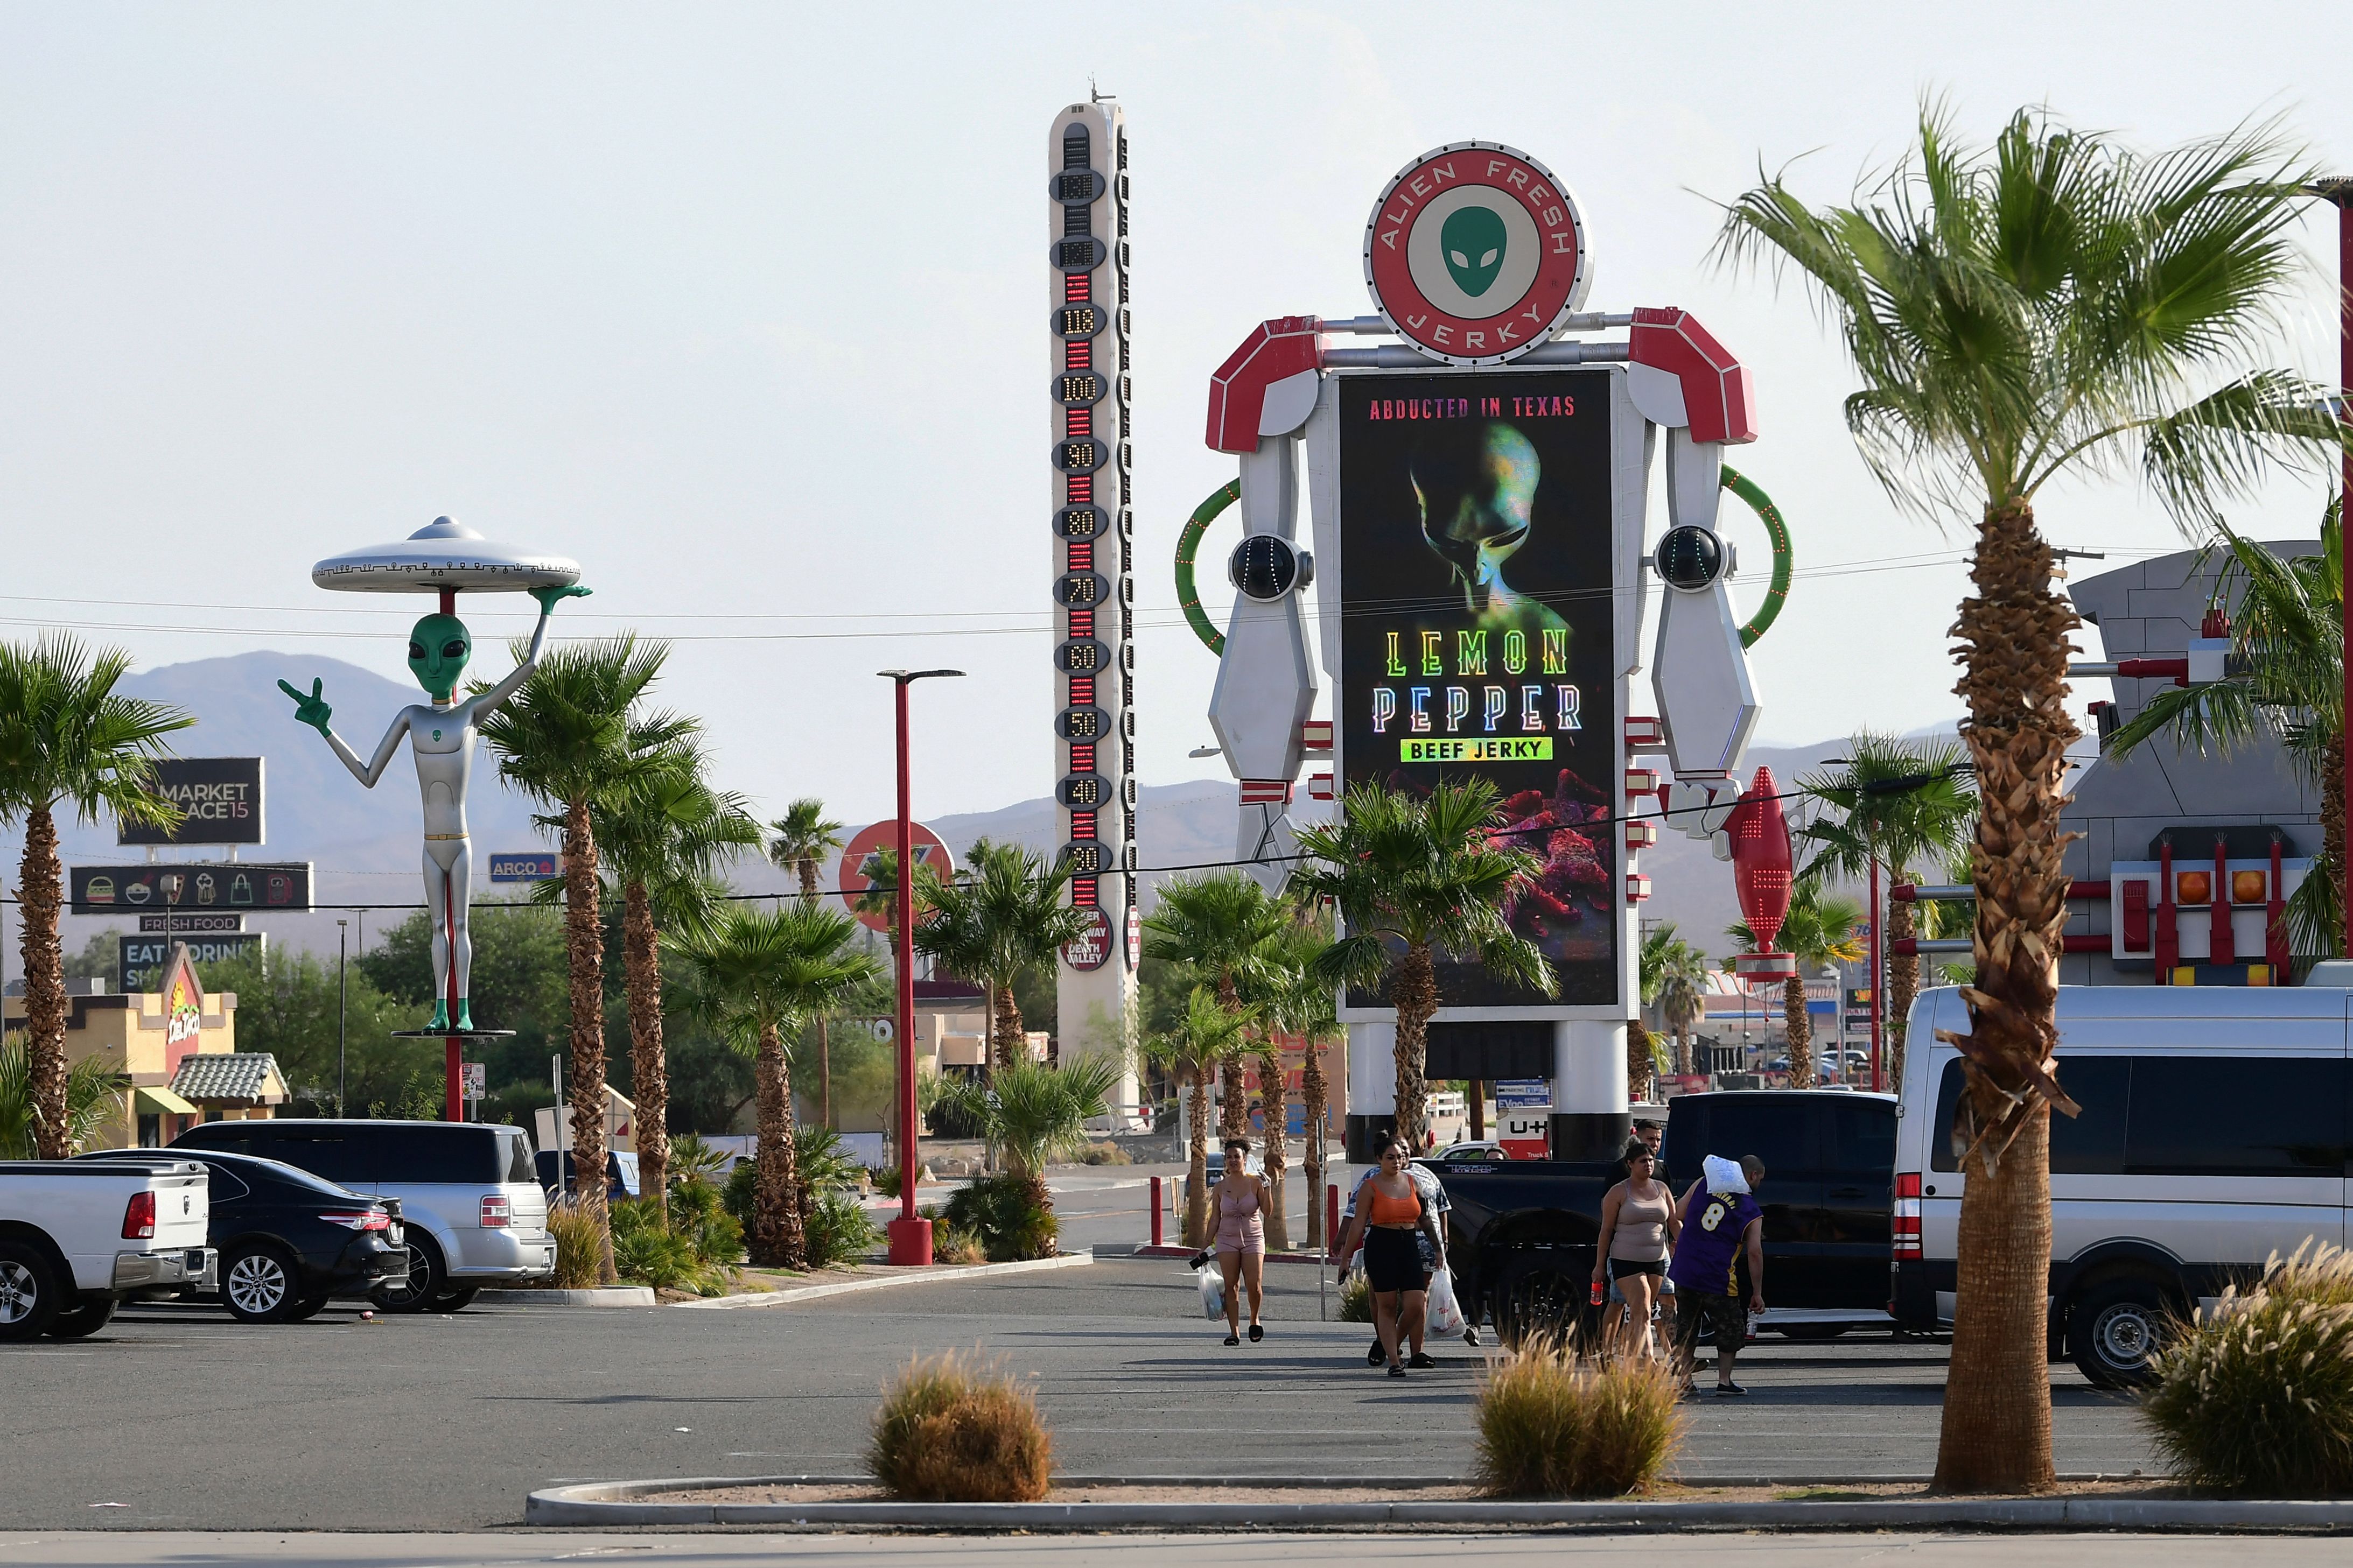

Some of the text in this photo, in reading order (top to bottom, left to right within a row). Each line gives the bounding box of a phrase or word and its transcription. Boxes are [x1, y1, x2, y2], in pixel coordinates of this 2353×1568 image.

[1381, 160, 1571, 254] ALIEN FRESH
[1065, 309, 1094, 334] 118
[1406, 303, 1541, 348] JERKY
[1064, 376, 1096, 401] 100
[1369, 396, 1575, 420] ABDUCTED IN TEXAS
[1069, 444, 1093, 467] 90
[1069, 511, 1093, 535] 80
[1070, 578, 1094, 602] 70
[1071, 645, 1095, 669] 60
[1386, 629, 1567, 677] LEMON
[1372, 685, 1582, 733] PEPPER
[1072, 712, 1096, 736] 50
[1411, 741, 1542, 759] BEEF JERKY
[159, 783, 249, 802] MARKET
[1073, 779, 1096, 804] 40
[493, 862, 537, 874] ARCO
[1074, 847, 1097, 871] 30
[144, 918, 235, 930] FRESH FOOD
[127, 944, 165, 963] EAT
[1067, 953, 1102, 964] VALLEY
[1701, 1202, 1725, 1232] 8
